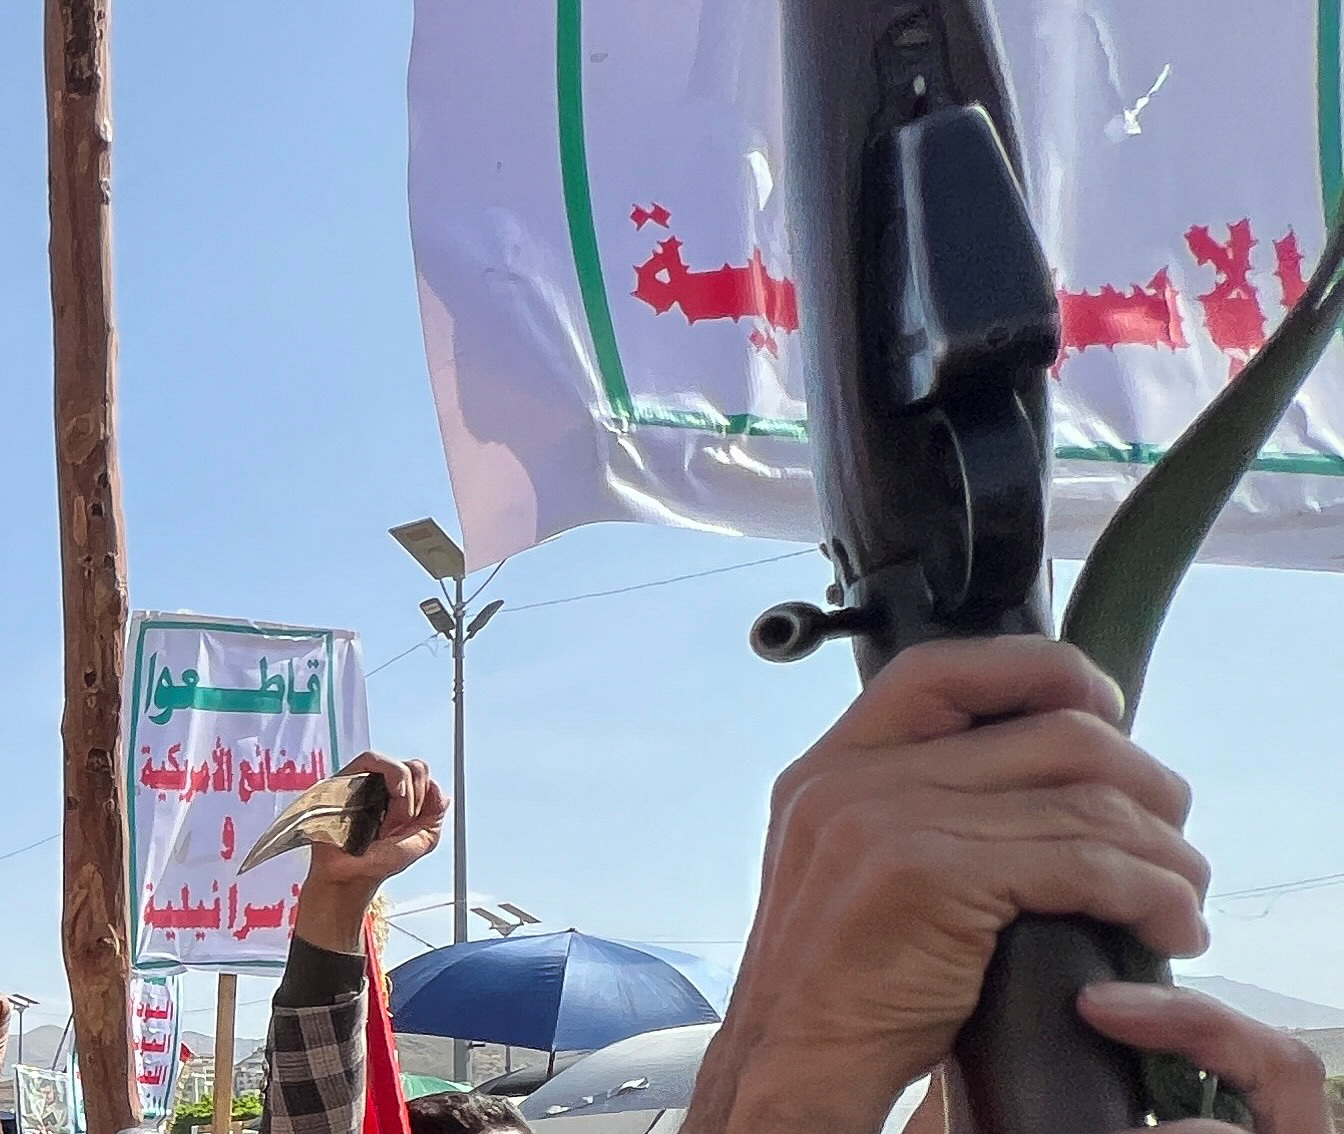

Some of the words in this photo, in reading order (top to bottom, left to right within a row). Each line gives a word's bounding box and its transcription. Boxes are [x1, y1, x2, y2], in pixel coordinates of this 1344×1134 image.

[144, 652, 321, 725] قاطعوا
[238, 743, 326, 804] البضائع
[220, 816, 235, 861] و
